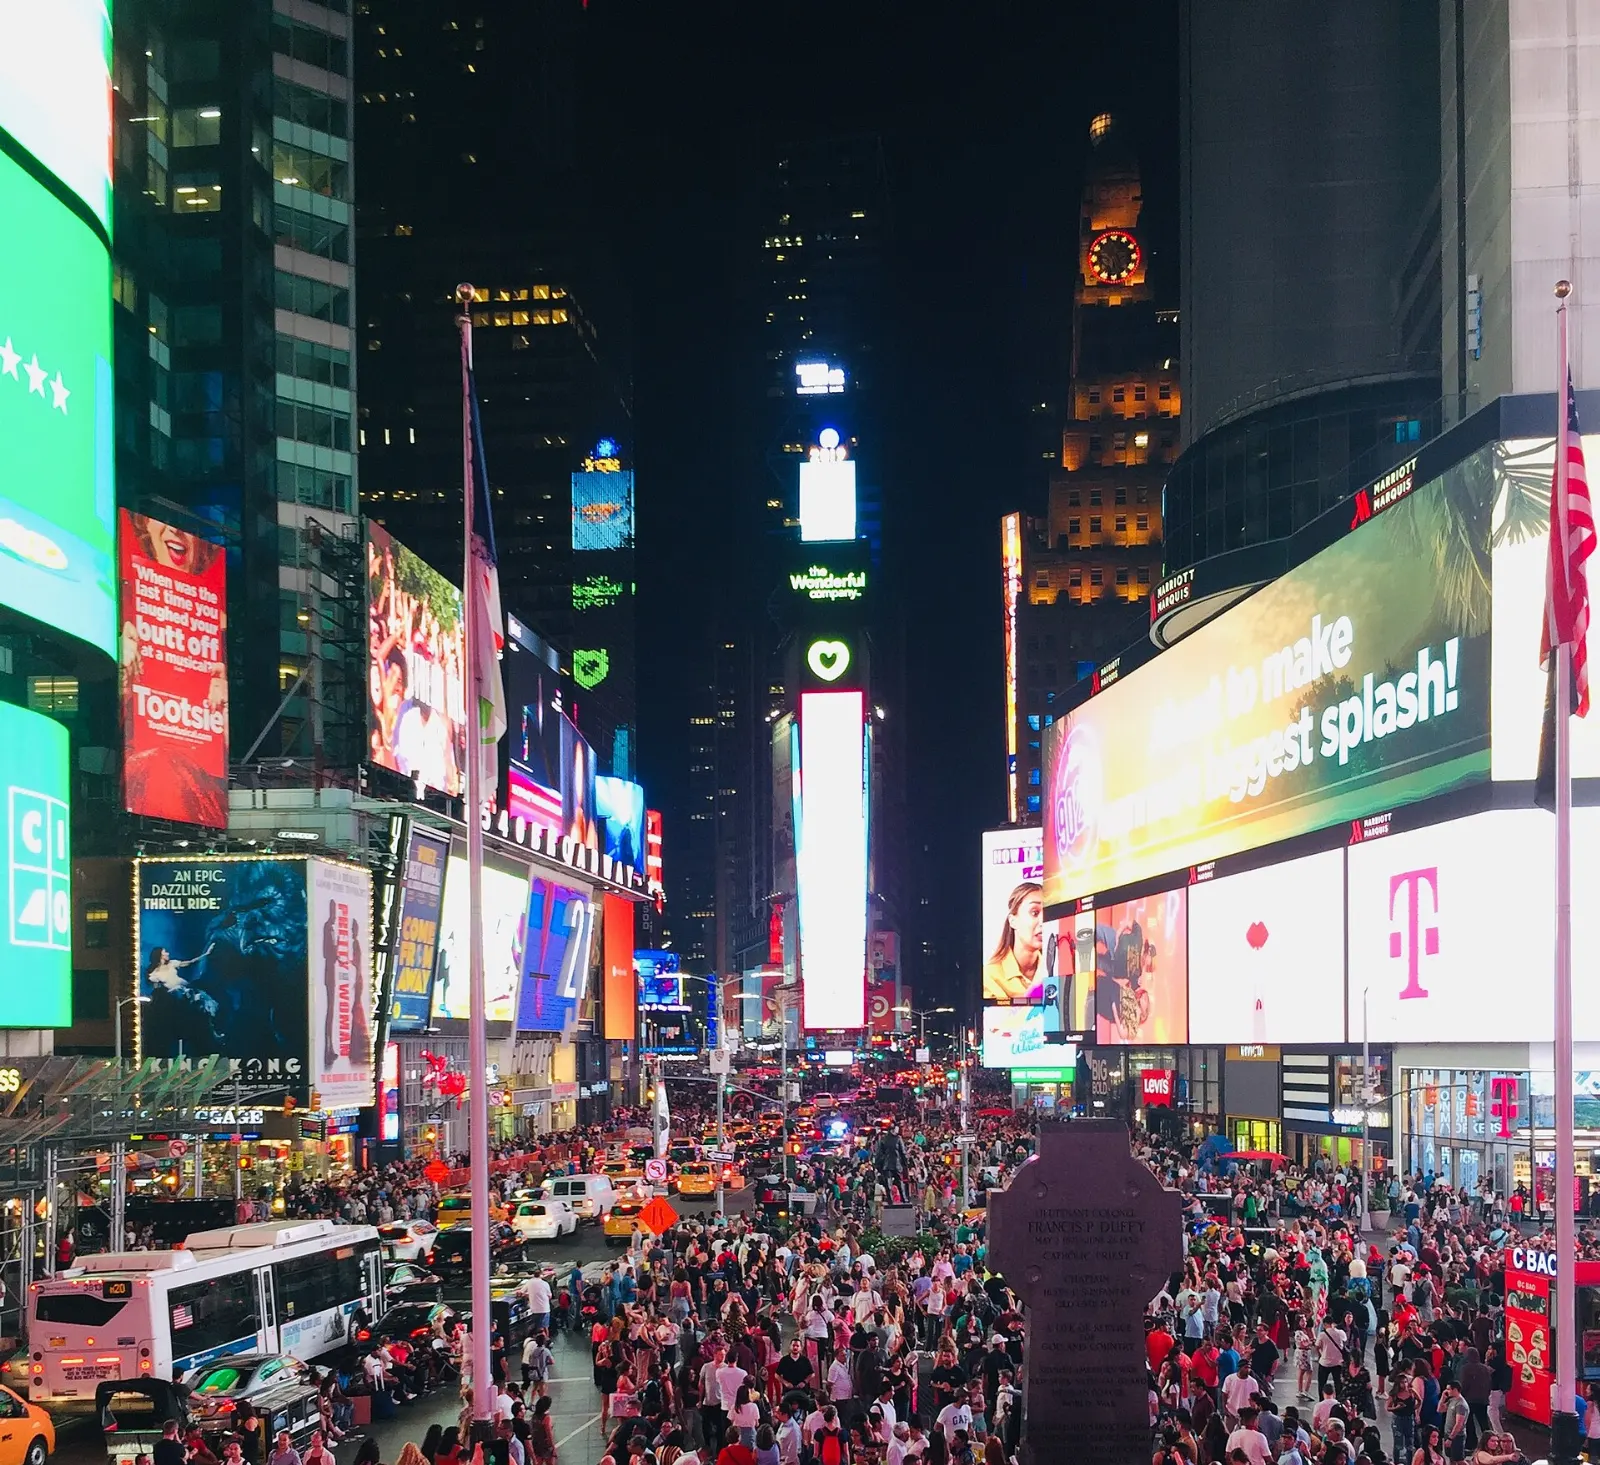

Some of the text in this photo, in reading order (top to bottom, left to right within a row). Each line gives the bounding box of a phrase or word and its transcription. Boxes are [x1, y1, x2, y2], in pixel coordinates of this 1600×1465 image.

[1373, 456, 1418, 496] MARRIOTT
[1373, 477, 1412, 511] MARQUIS
[789, 572, 866, 591] Wonderful
[809, 565, 828, 577] the
[1157, 568, 1195, 599] MARRIOTT
[135, 579, 218, 619] last time you
[174, 580, 197, 598] was
[198, 585, 218, 604] the
[1157, 586, 1190, 614] MARQUIS
[135, 597, 219, 635] laughed your
[136, 614, 219, 661] butt off
[141, 645, 154, 658] at
[155, 649, 164, 661] a
[1262, 614, 1354, 704] make
[132, 683, 224, 734] Tootsie
[1320, 636, 1459, 766] splash!
[144, 897, 184, 910] THRILL
[151, 883, 211, 897] DAZZLING
[336, 903, 351, 971] PRETTY
[402, 915, 436, 945] COME
[1389, 866, 1439, 1000] T
[563, 898, 596, 999] 21
[395, 967, 431, 994] AWAY
[337, 983, 351, 1057] WOMAN
[229, 1057, 302, 1074] KONG
[1092, 1059, 1108, 1081] BIG
[1490, 1077, 1519, 1139] T
[1028, 1220, 1083, 1234] FRANCIS
[1100, 1220, 1146, 1234] DUFFY
